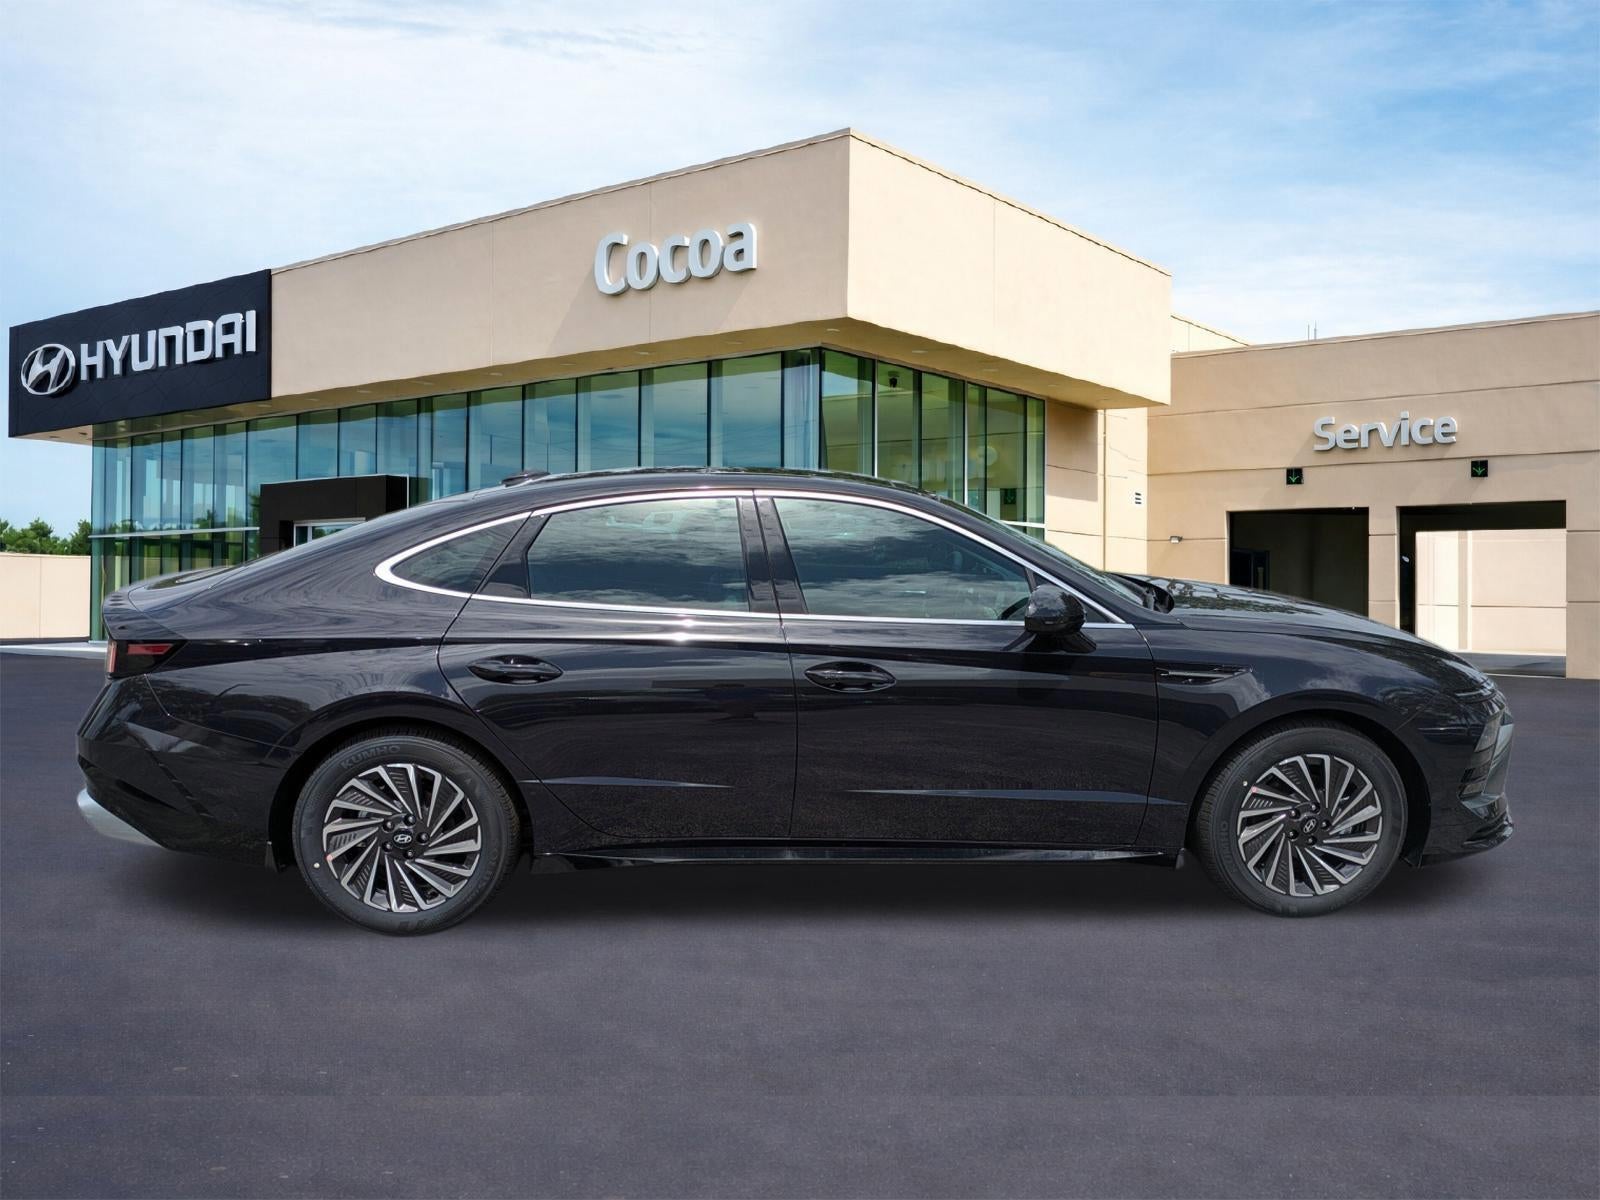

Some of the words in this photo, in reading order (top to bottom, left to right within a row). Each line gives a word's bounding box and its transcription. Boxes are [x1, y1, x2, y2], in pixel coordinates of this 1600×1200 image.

[594, 223, 757, 295] Cocoa
[80, 310, 256, 381] HYUNDAI
[1313, 411, 1458, 451] Service
[340, 745, 400, 769] KUMHO
